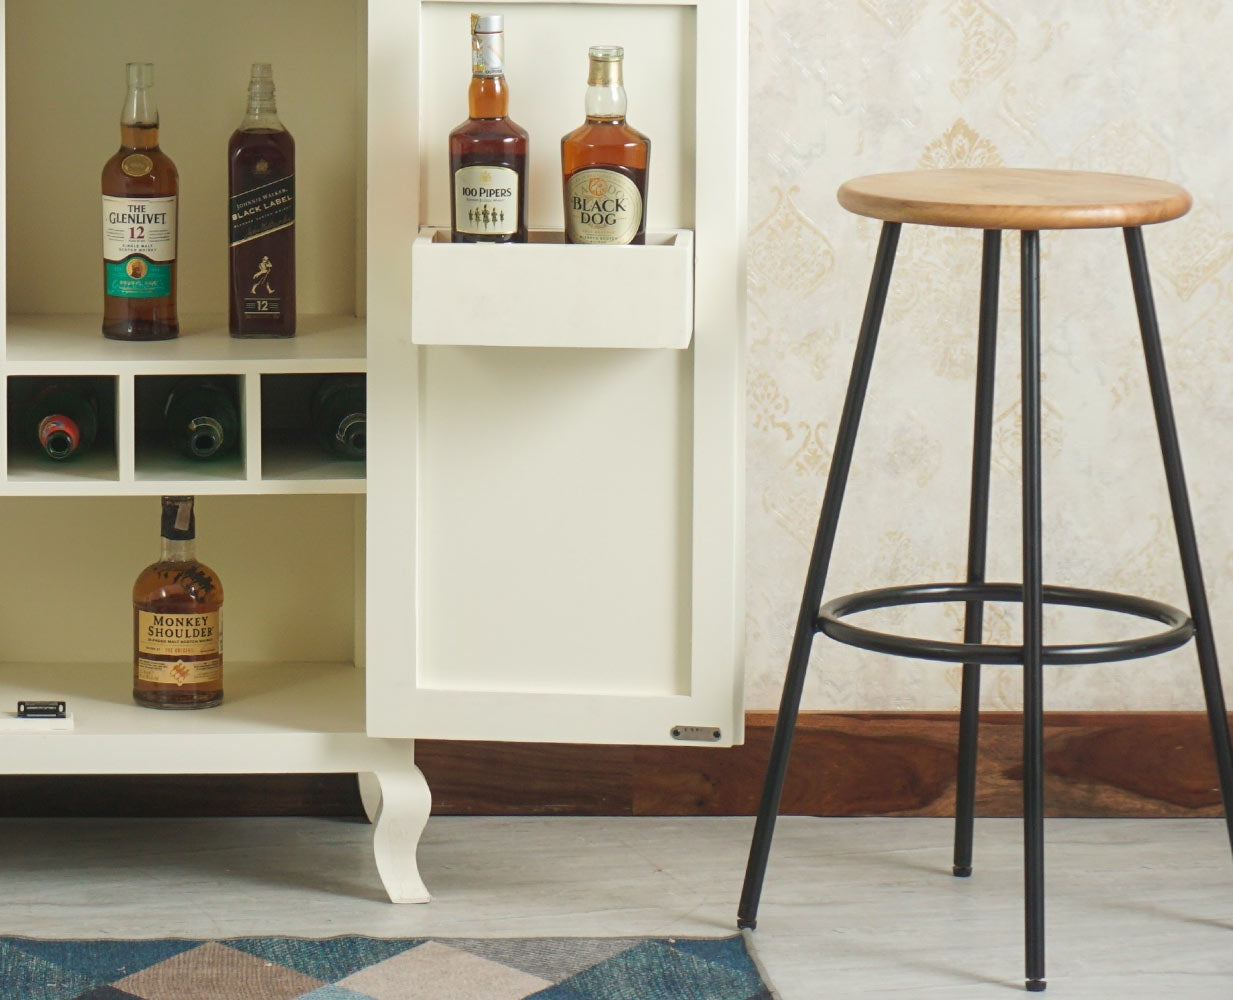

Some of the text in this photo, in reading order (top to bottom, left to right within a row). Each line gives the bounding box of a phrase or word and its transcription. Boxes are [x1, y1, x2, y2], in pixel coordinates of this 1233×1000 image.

[462, 187, 512, 198] 100 PIPERS
[128, 205, 146, 213] THE
[232, 206, 262, 221] BLACK
[263, 195, 293, 209] LABEL
[573, 196, 626, 212] BLACK
[109, 212, 167, 225] GLENLIVET
[580, 213, 617, 226] DOG
[129, 226, 145, 239] 12
[256, 301, 269, 311] 12
[153, 615, 209, 627] MONKEY
[148, 627, 214, 639] SHOULDER
